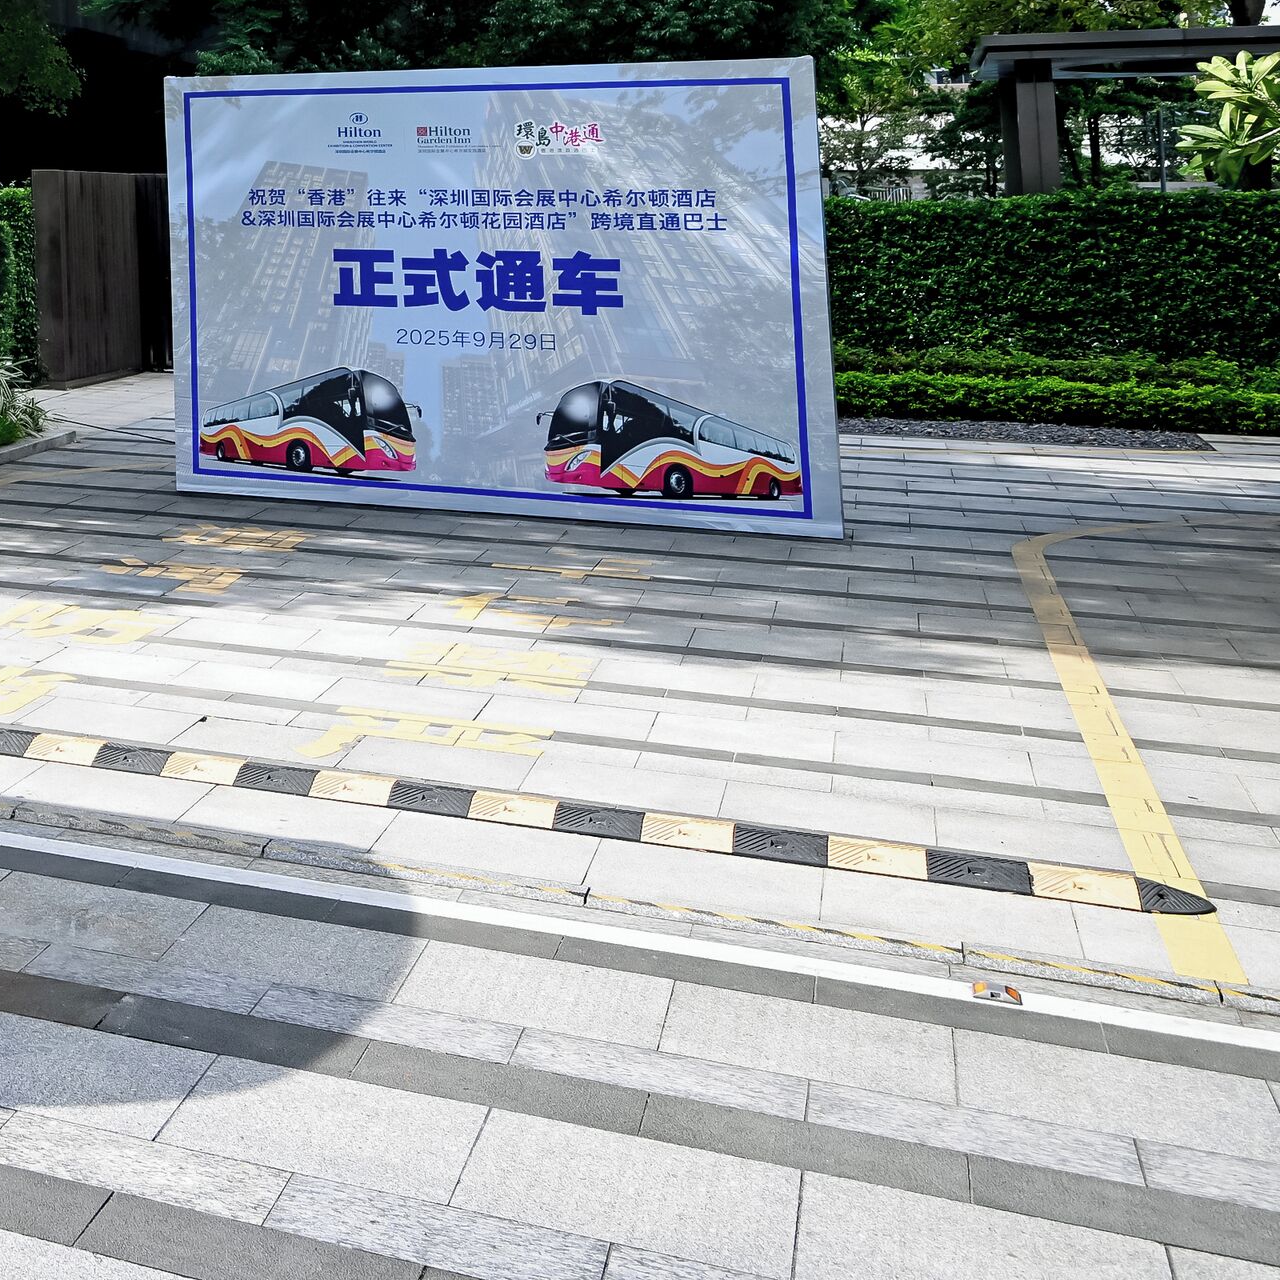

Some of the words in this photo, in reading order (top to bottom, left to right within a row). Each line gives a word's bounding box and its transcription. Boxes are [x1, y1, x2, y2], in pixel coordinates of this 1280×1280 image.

[337, 126, 382, 138] Hilton
[429, 126, 471, 136] Hilton
[516, 121, 604, 147] 環島中港通
[333, 248, 624, 316] 正式通车
[396, 328, 557, 352] 2025年9月29日
